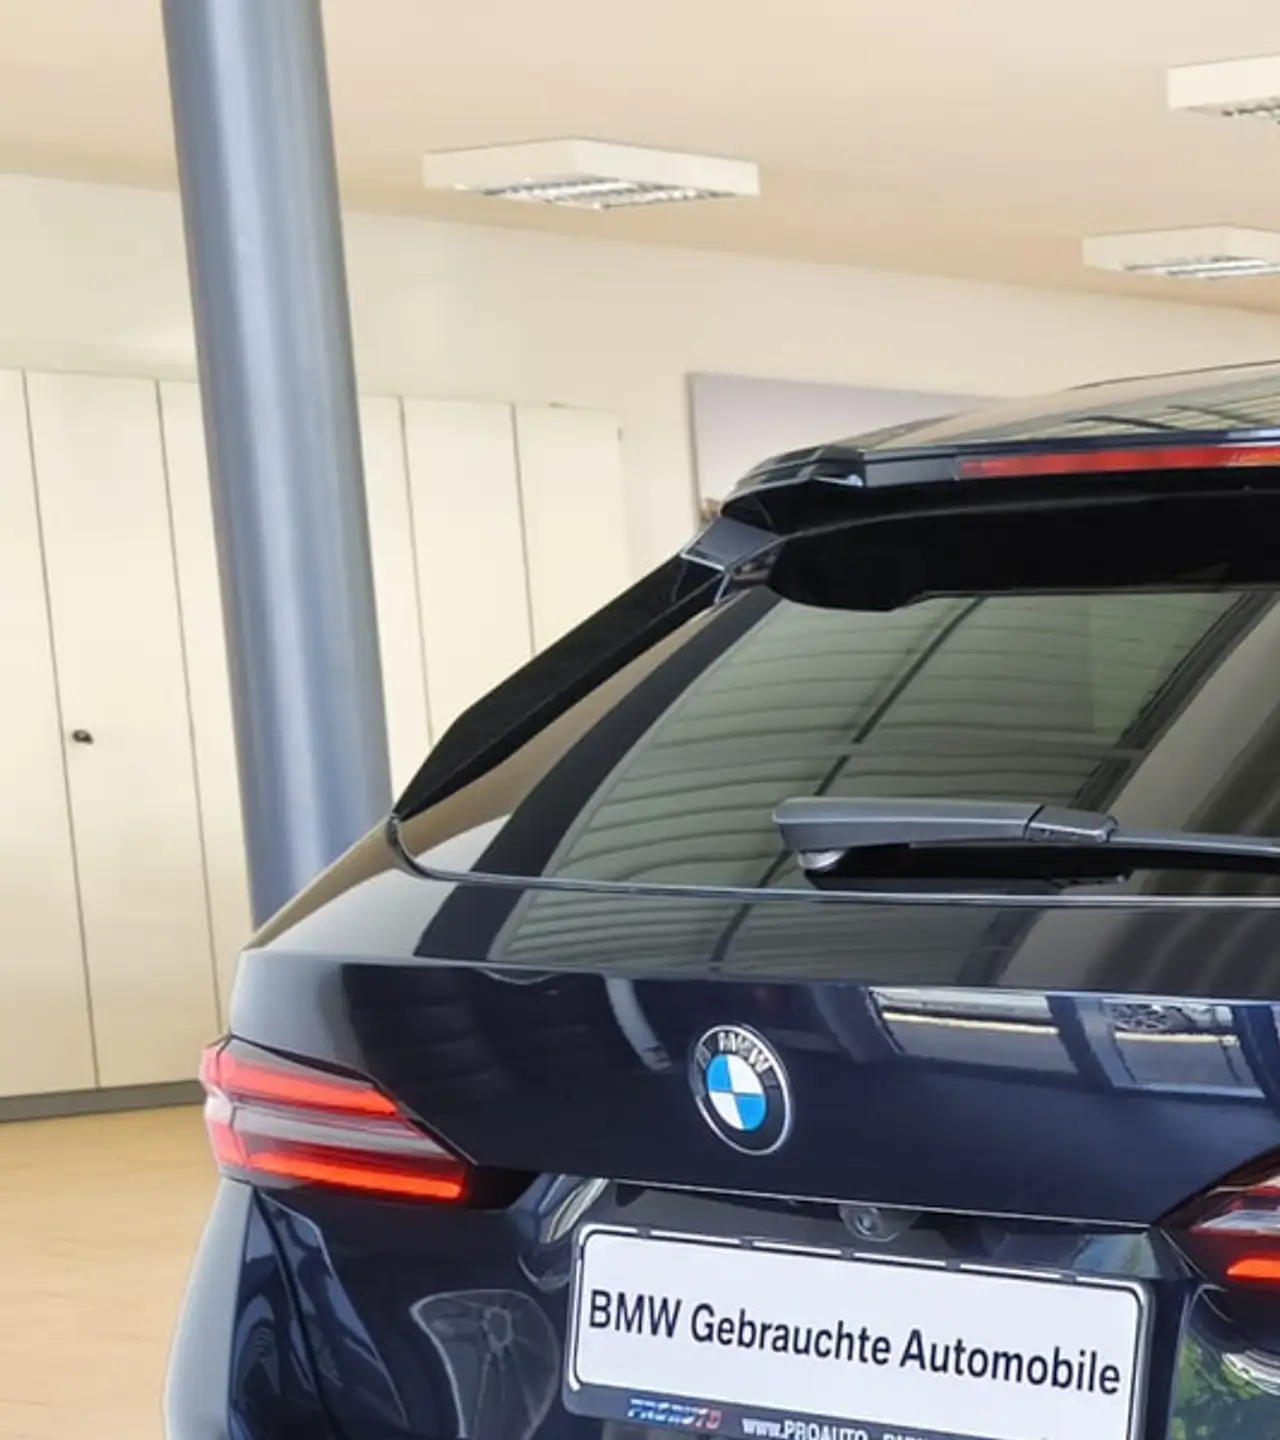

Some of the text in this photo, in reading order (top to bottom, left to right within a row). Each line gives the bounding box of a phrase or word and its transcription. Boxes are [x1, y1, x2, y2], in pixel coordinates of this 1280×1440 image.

[717, 1032, 772, 1073] BMW
[589, 1289, 1121, 1395] BMW Gebrauchte Automobile
